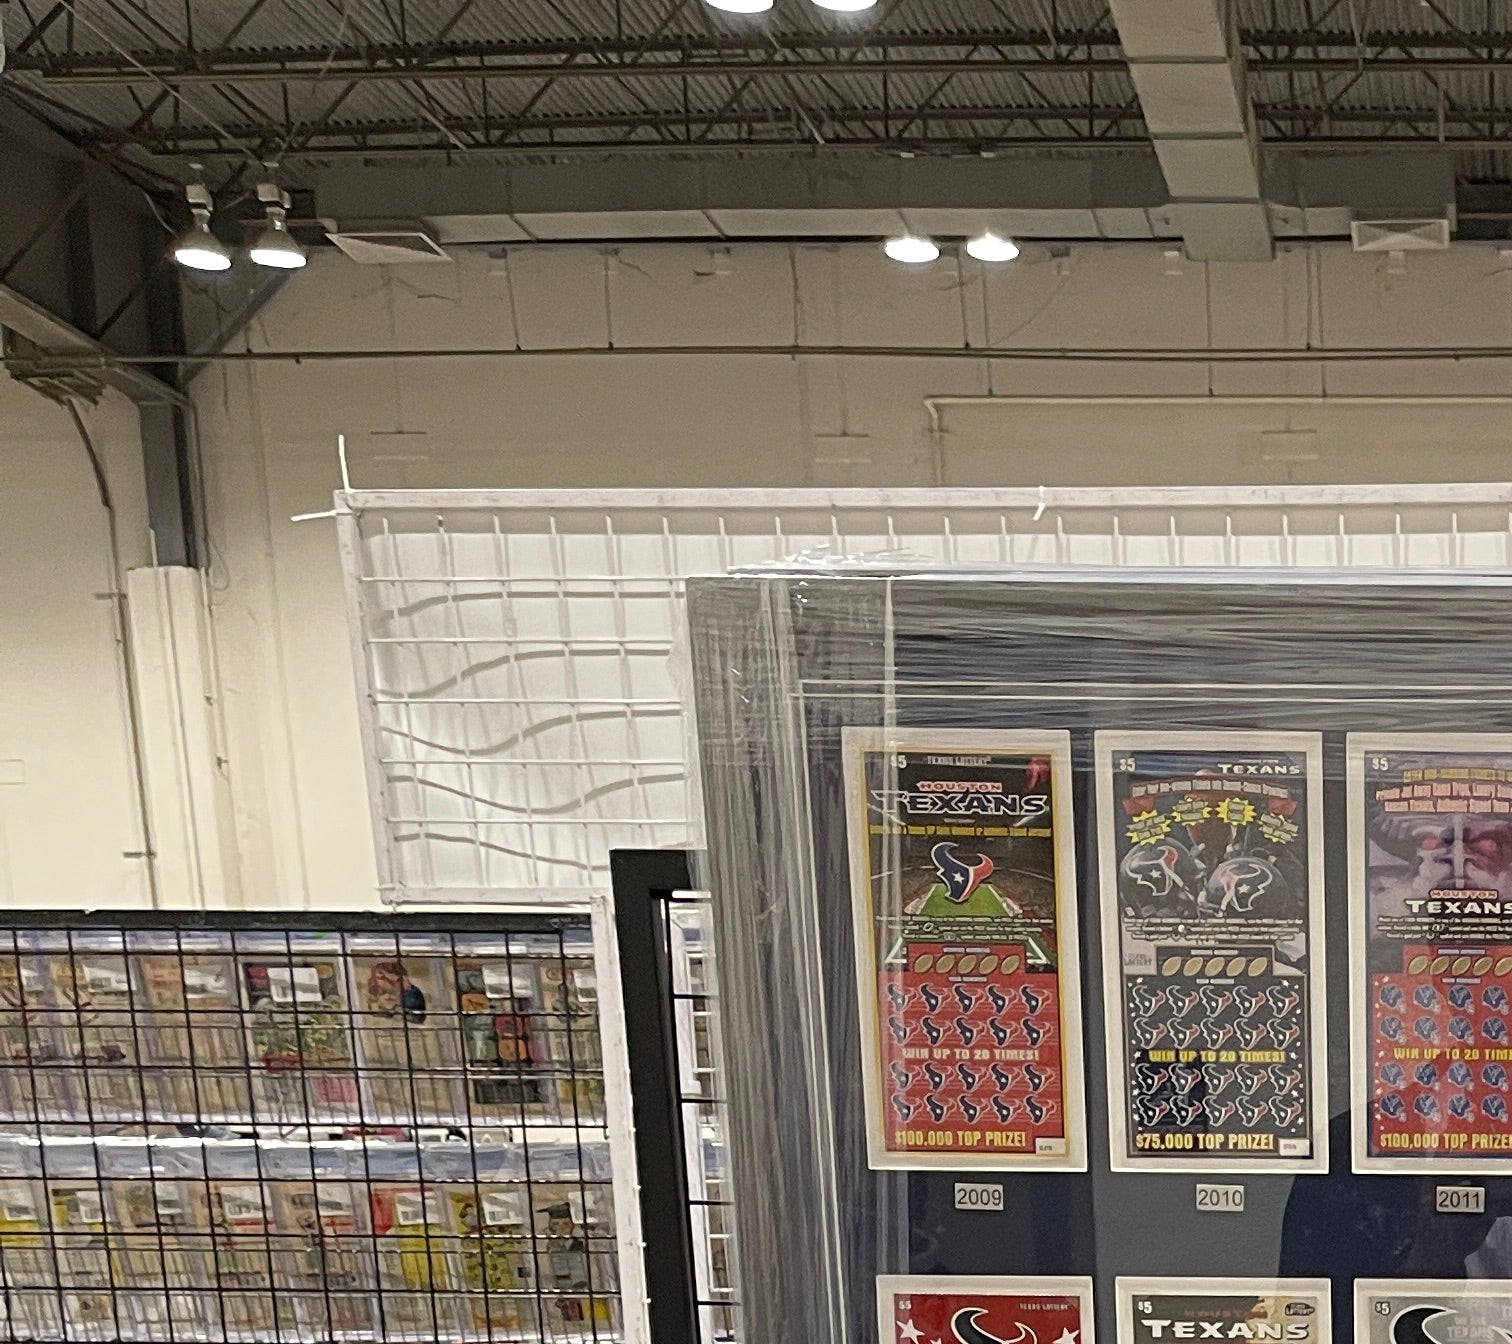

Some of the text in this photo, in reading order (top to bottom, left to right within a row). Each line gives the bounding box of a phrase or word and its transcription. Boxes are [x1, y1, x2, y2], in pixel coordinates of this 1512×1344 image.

[1218, 763, 1300, 774] TEXANS
[917, 781, 1002, 792] HOUSTON
[871, 790, 1047, 815] TEXANS
[1430, 890, 1497, 899] HOUSTON
[1394, 1048, 1419, 1059] WIN
[1424, 1048, 1440, 1060] UP
[1446, 1048, 1460, 1060] TO
[1464, 1049, 1480, 1060] 20
[1380, 1133, 1512, 1149] $100,000 TOP PRIZE!
[957, 1188, 1002, 1206] 2009
[1198, 1190, 1243, 1206] 2010
[1438, 1190, 1480, 1208] 2011
[1141, 1319, 1309, 1339] TEXANS
